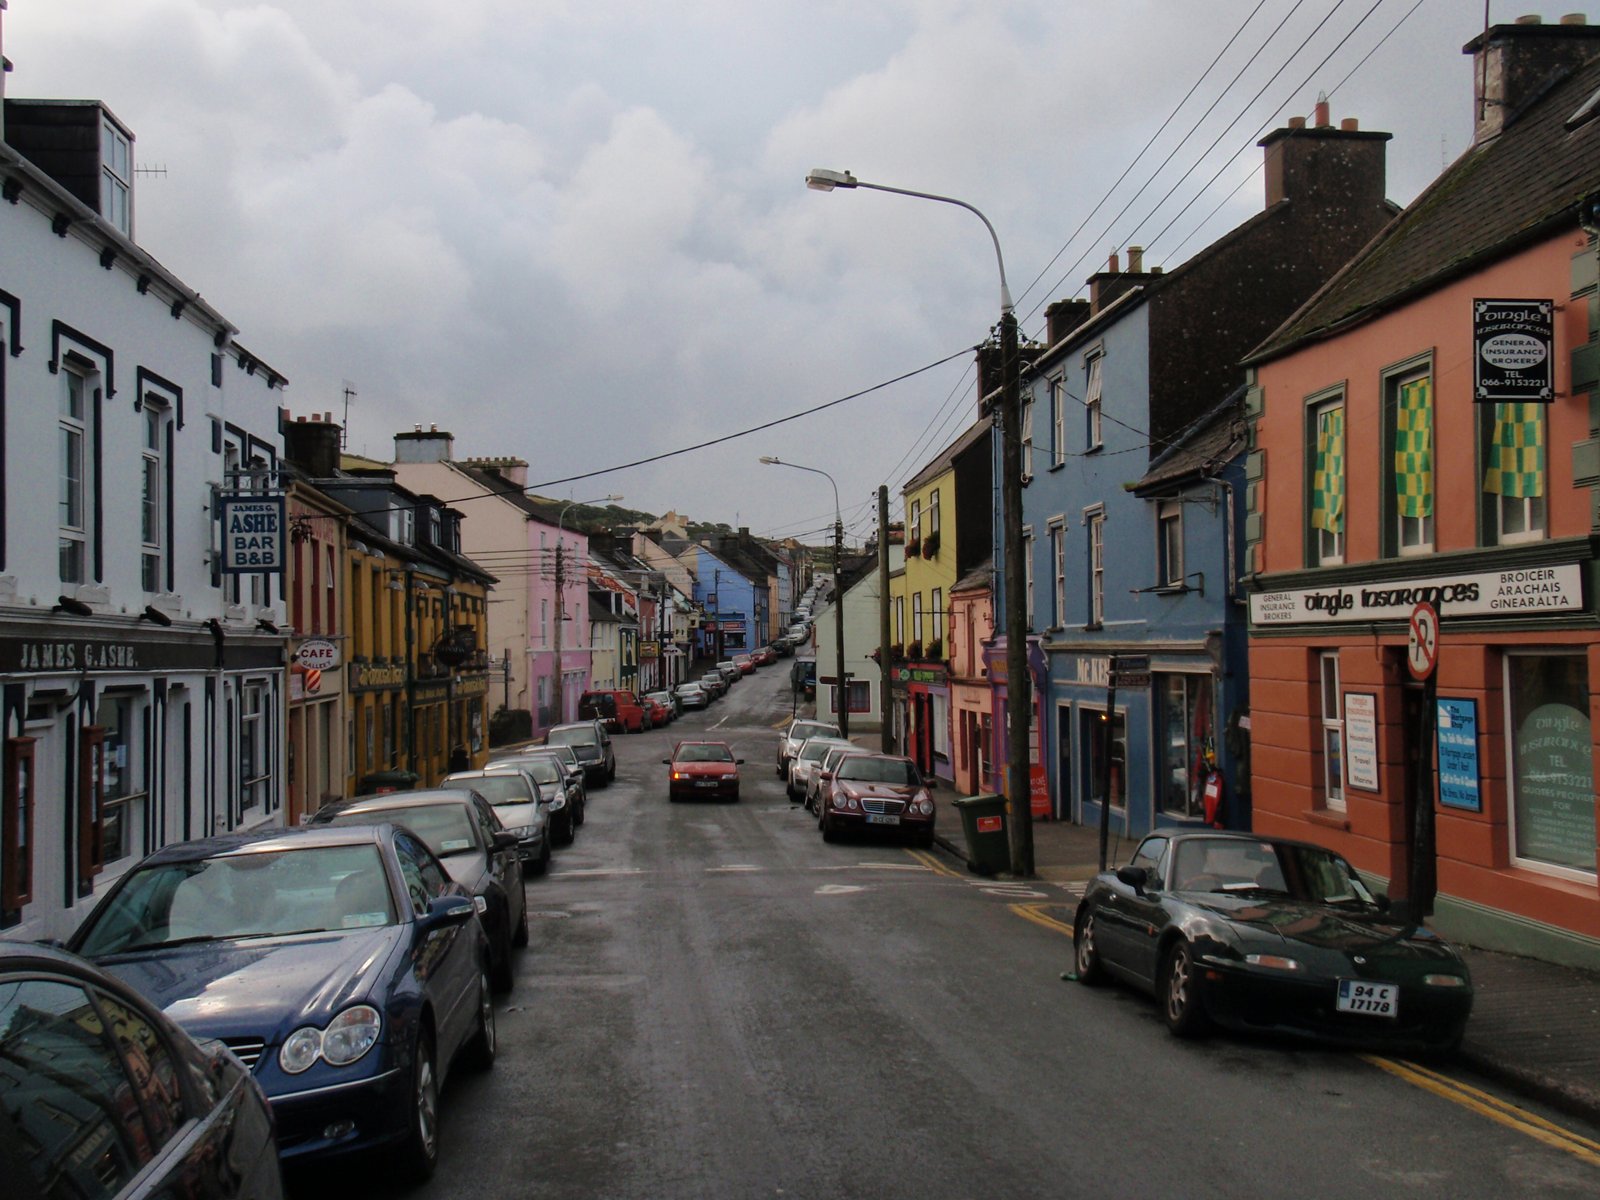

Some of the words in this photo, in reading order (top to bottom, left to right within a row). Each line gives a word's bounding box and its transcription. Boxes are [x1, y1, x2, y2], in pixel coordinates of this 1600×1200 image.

[1504, 370, 1523, 378] TEL.
[1481, 379, 1546, 387] 066-9153221
[230, 514, 278, 533] ASHE
[235, 536, 274, 549] BAR
[235, 552, 274, 565] B&B
[1498, 582, 1561, 596] ARACHAIS
[1263, 593, 1292, 602] GENERAL
[1260, 602, 1295, 611] INSURANCE
[1264, 611, 1292, 620] BROKERS
[20, 643, 76, 669] JAMES
[302, 660, 331, 669] GALLERY
[1354, 985, 1374, 997] 94
[1379, 989, 1389, 999] C
[1350, 998, 1390, 1013] 17178
